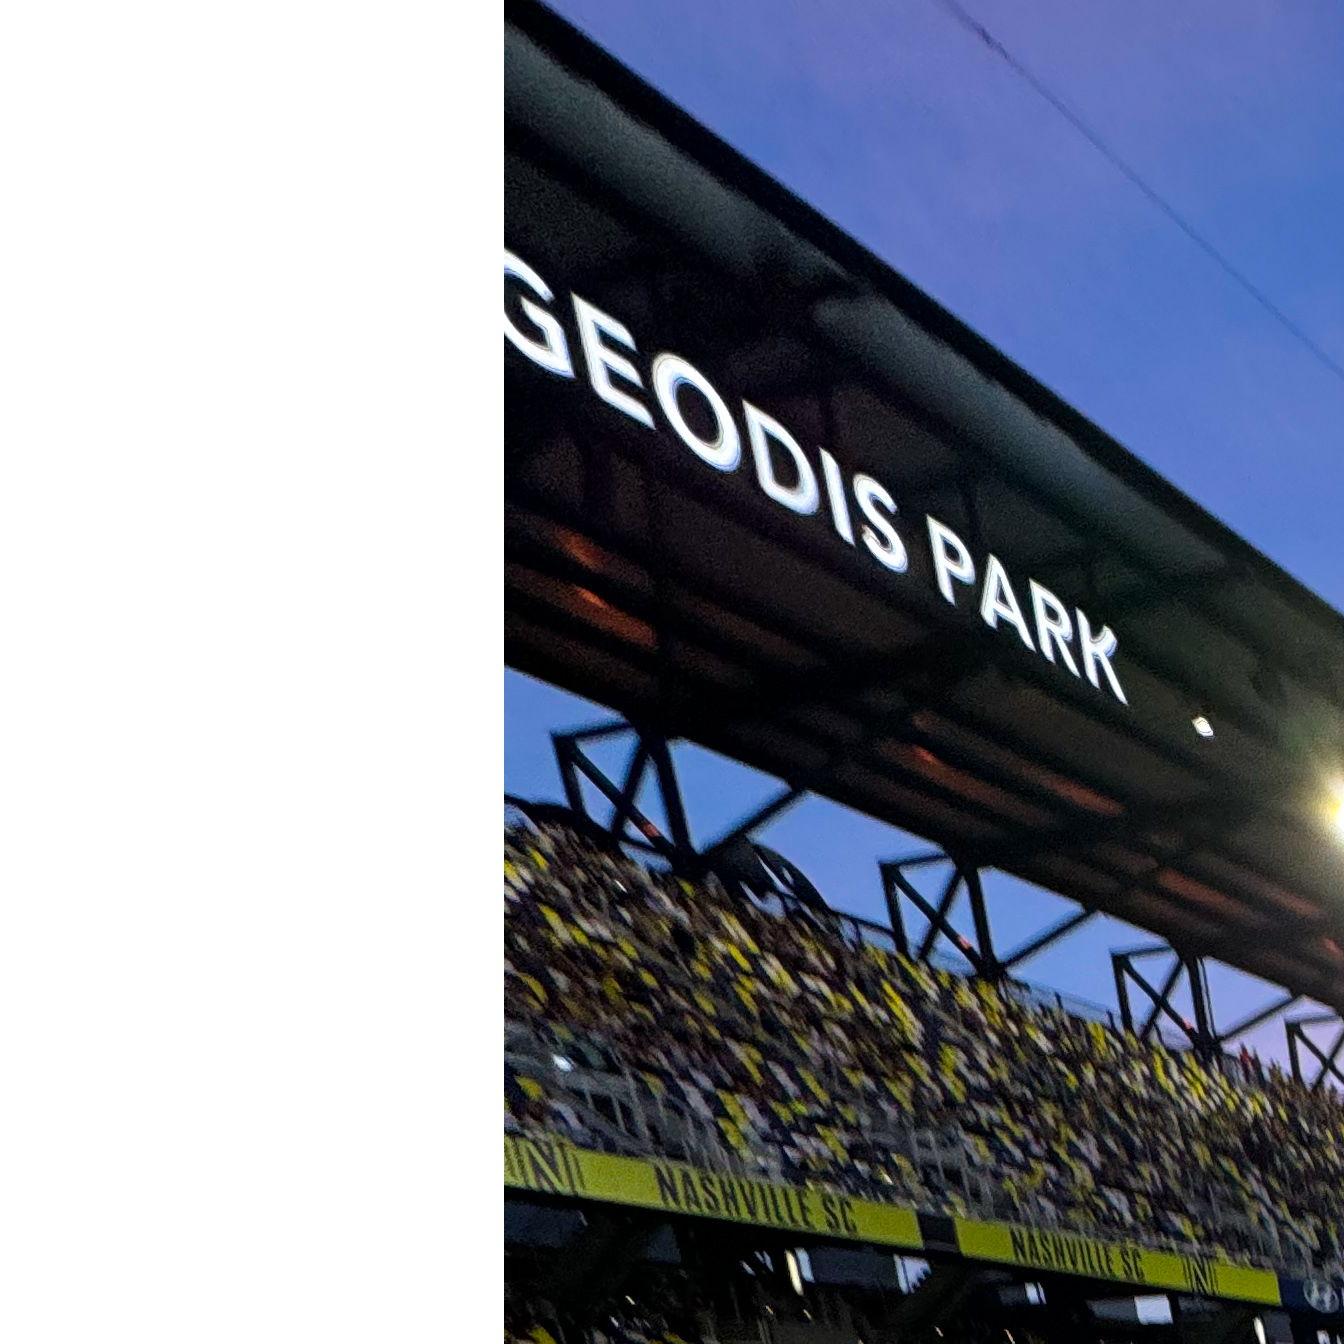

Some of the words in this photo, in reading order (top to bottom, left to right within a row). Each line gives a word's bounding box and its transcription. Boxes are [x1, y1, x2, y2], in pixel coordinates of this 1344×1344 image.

[504, 248, 908, 574] GEODIS
[926, 514, 1128, 705] PARK
[654, 1163, 811, 1229] NASHVILLE
[823, 1194, 859, 1236] SC
[1009, 1225, 1115, 1278] NASHVILLE
